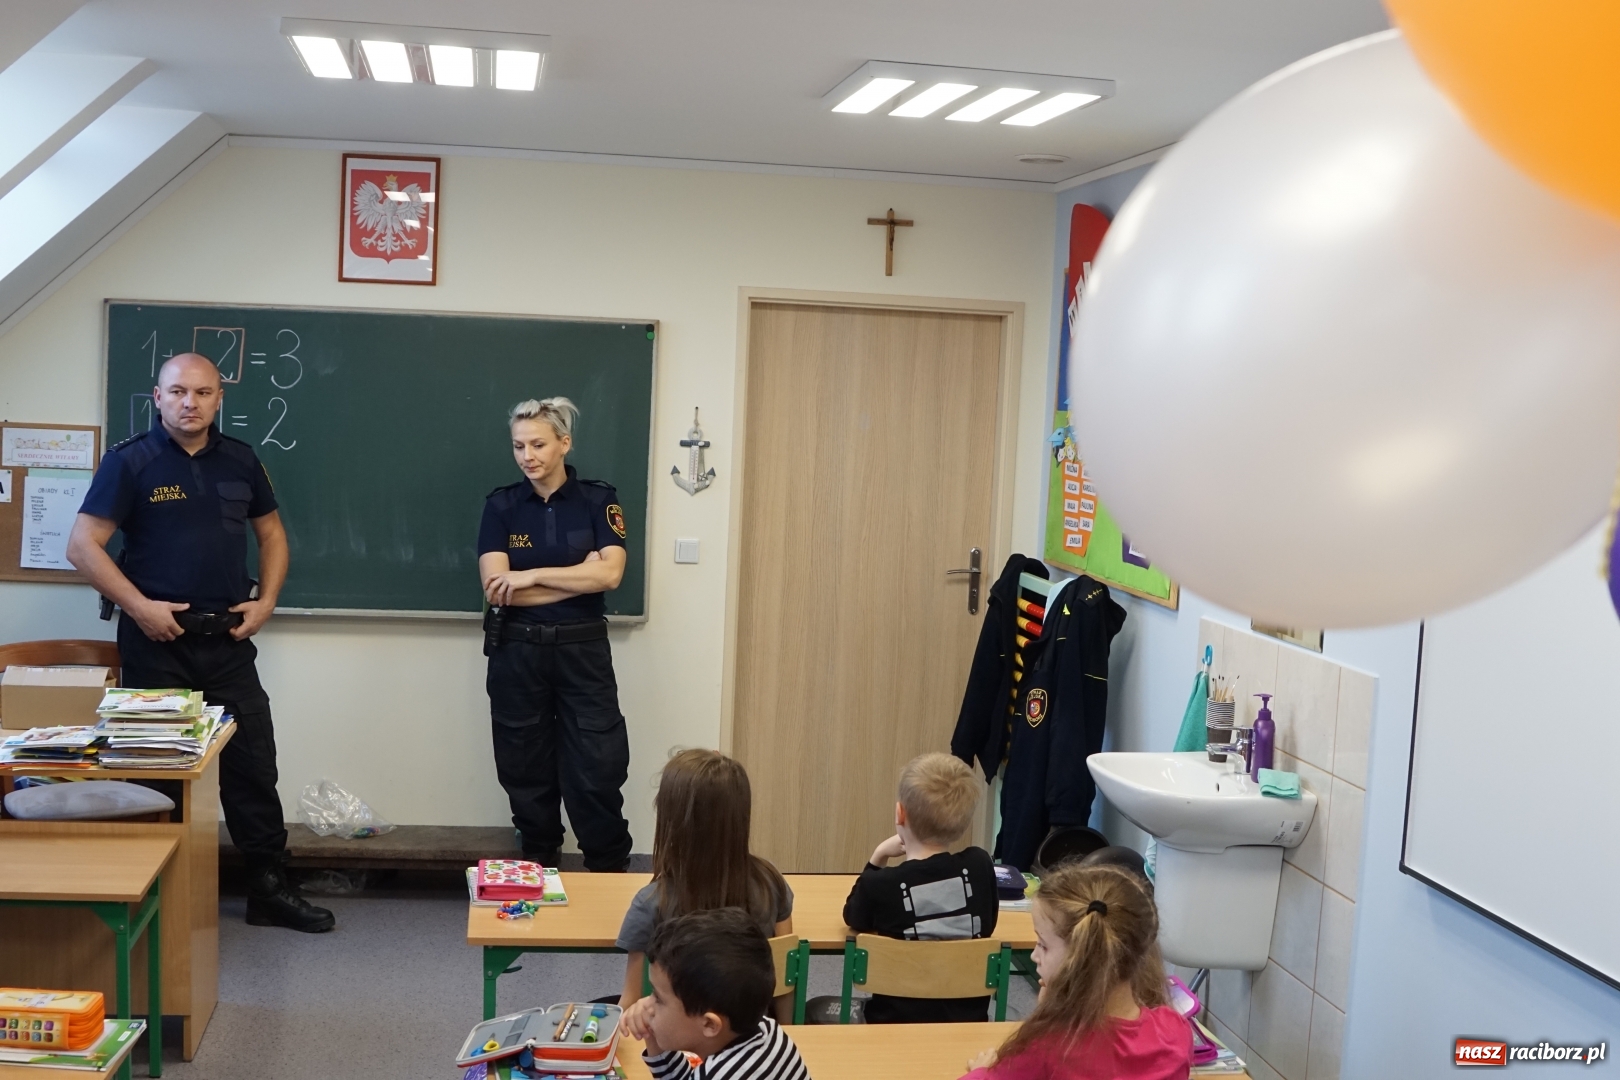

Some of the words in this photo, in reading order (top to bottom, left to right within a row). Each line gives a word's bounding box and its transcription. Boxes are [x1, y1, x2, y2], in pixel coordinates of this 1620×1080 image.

[216, 328, 237, 381] 2
[270, 328, 303, 390] 3
[260, 396, 297, 450] 2
[149, 493, 187, 502] MIEJSKA
[153, 485, 181, 495] STRAŻ
